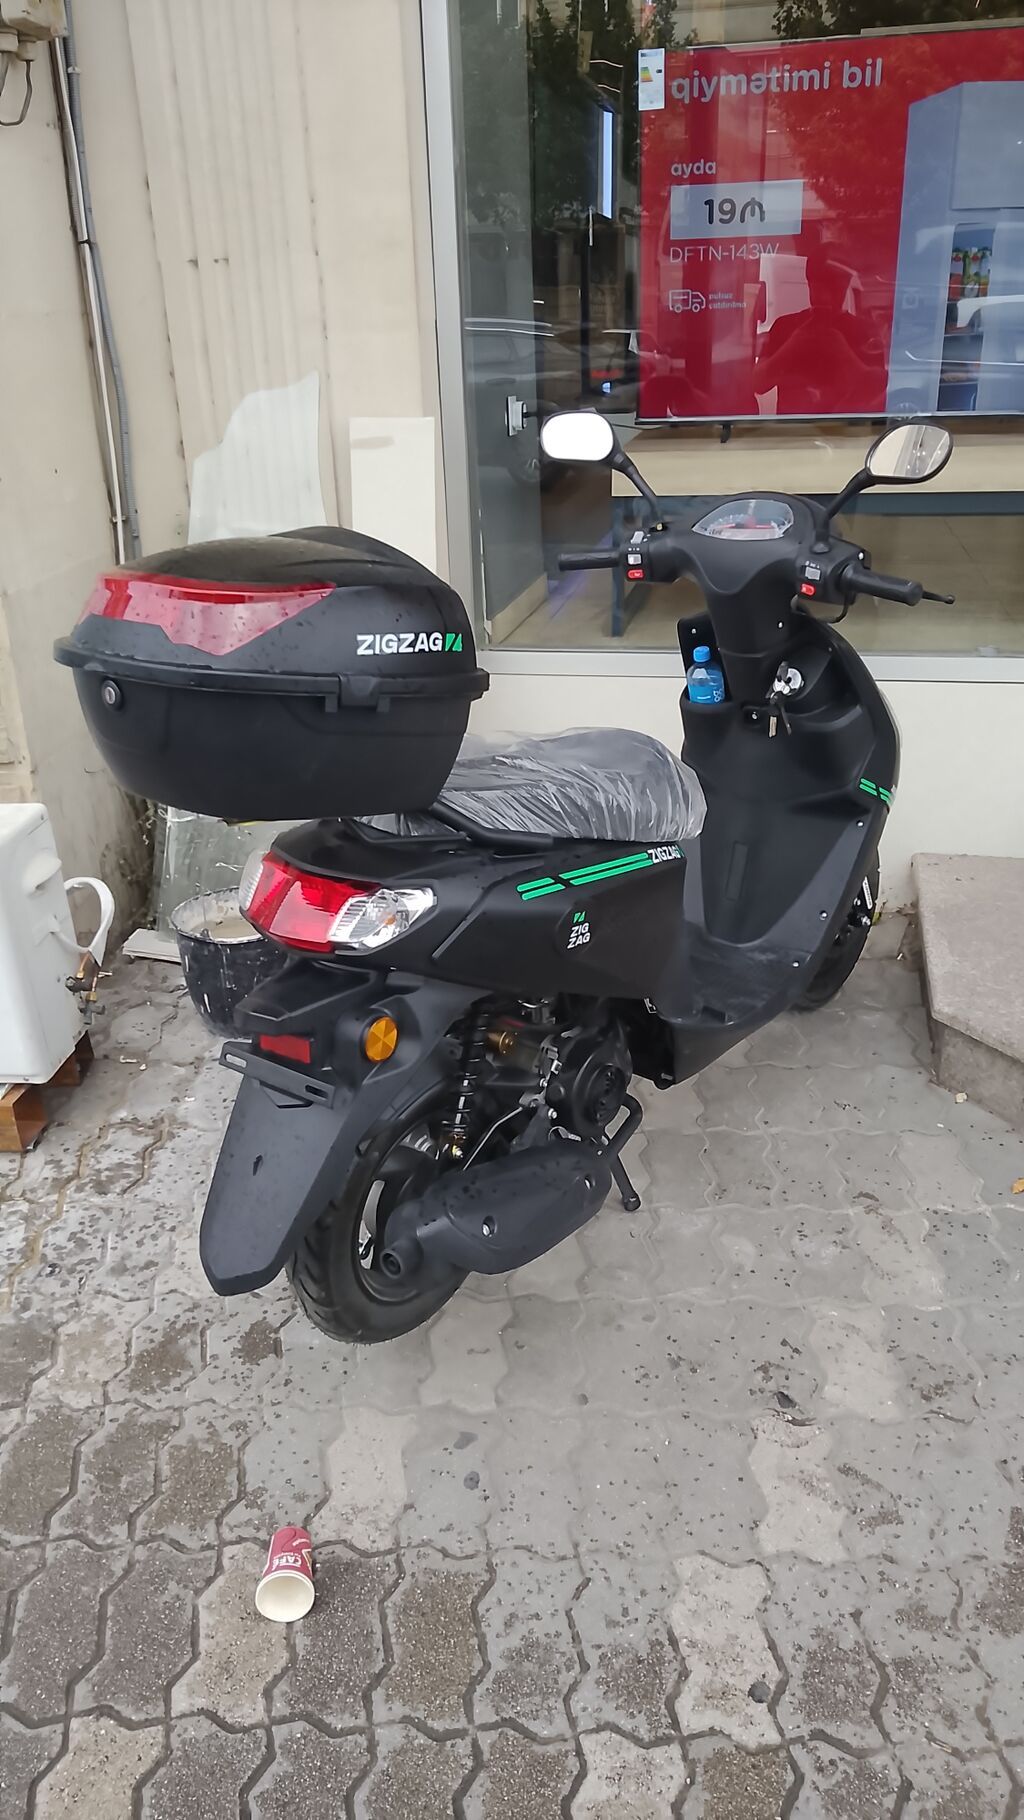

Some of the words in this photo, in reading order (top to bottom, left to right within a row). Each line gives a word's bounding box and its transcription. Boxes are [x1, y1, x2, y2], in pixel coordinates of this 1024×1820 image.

[671, 64, 831, 104] qiymətimi
[843, 58, 883, 89] bil
[671, 159, 716, 178] ayda
[670, 242, 779, 263] DFTN-143W
[356, 632, 443, 656] ZIGZAG
[647, 845, 681, 864] ZIGZAG
[570, 922, 590, 938] ZIG
[567, 932, 591, 949] ZAG
